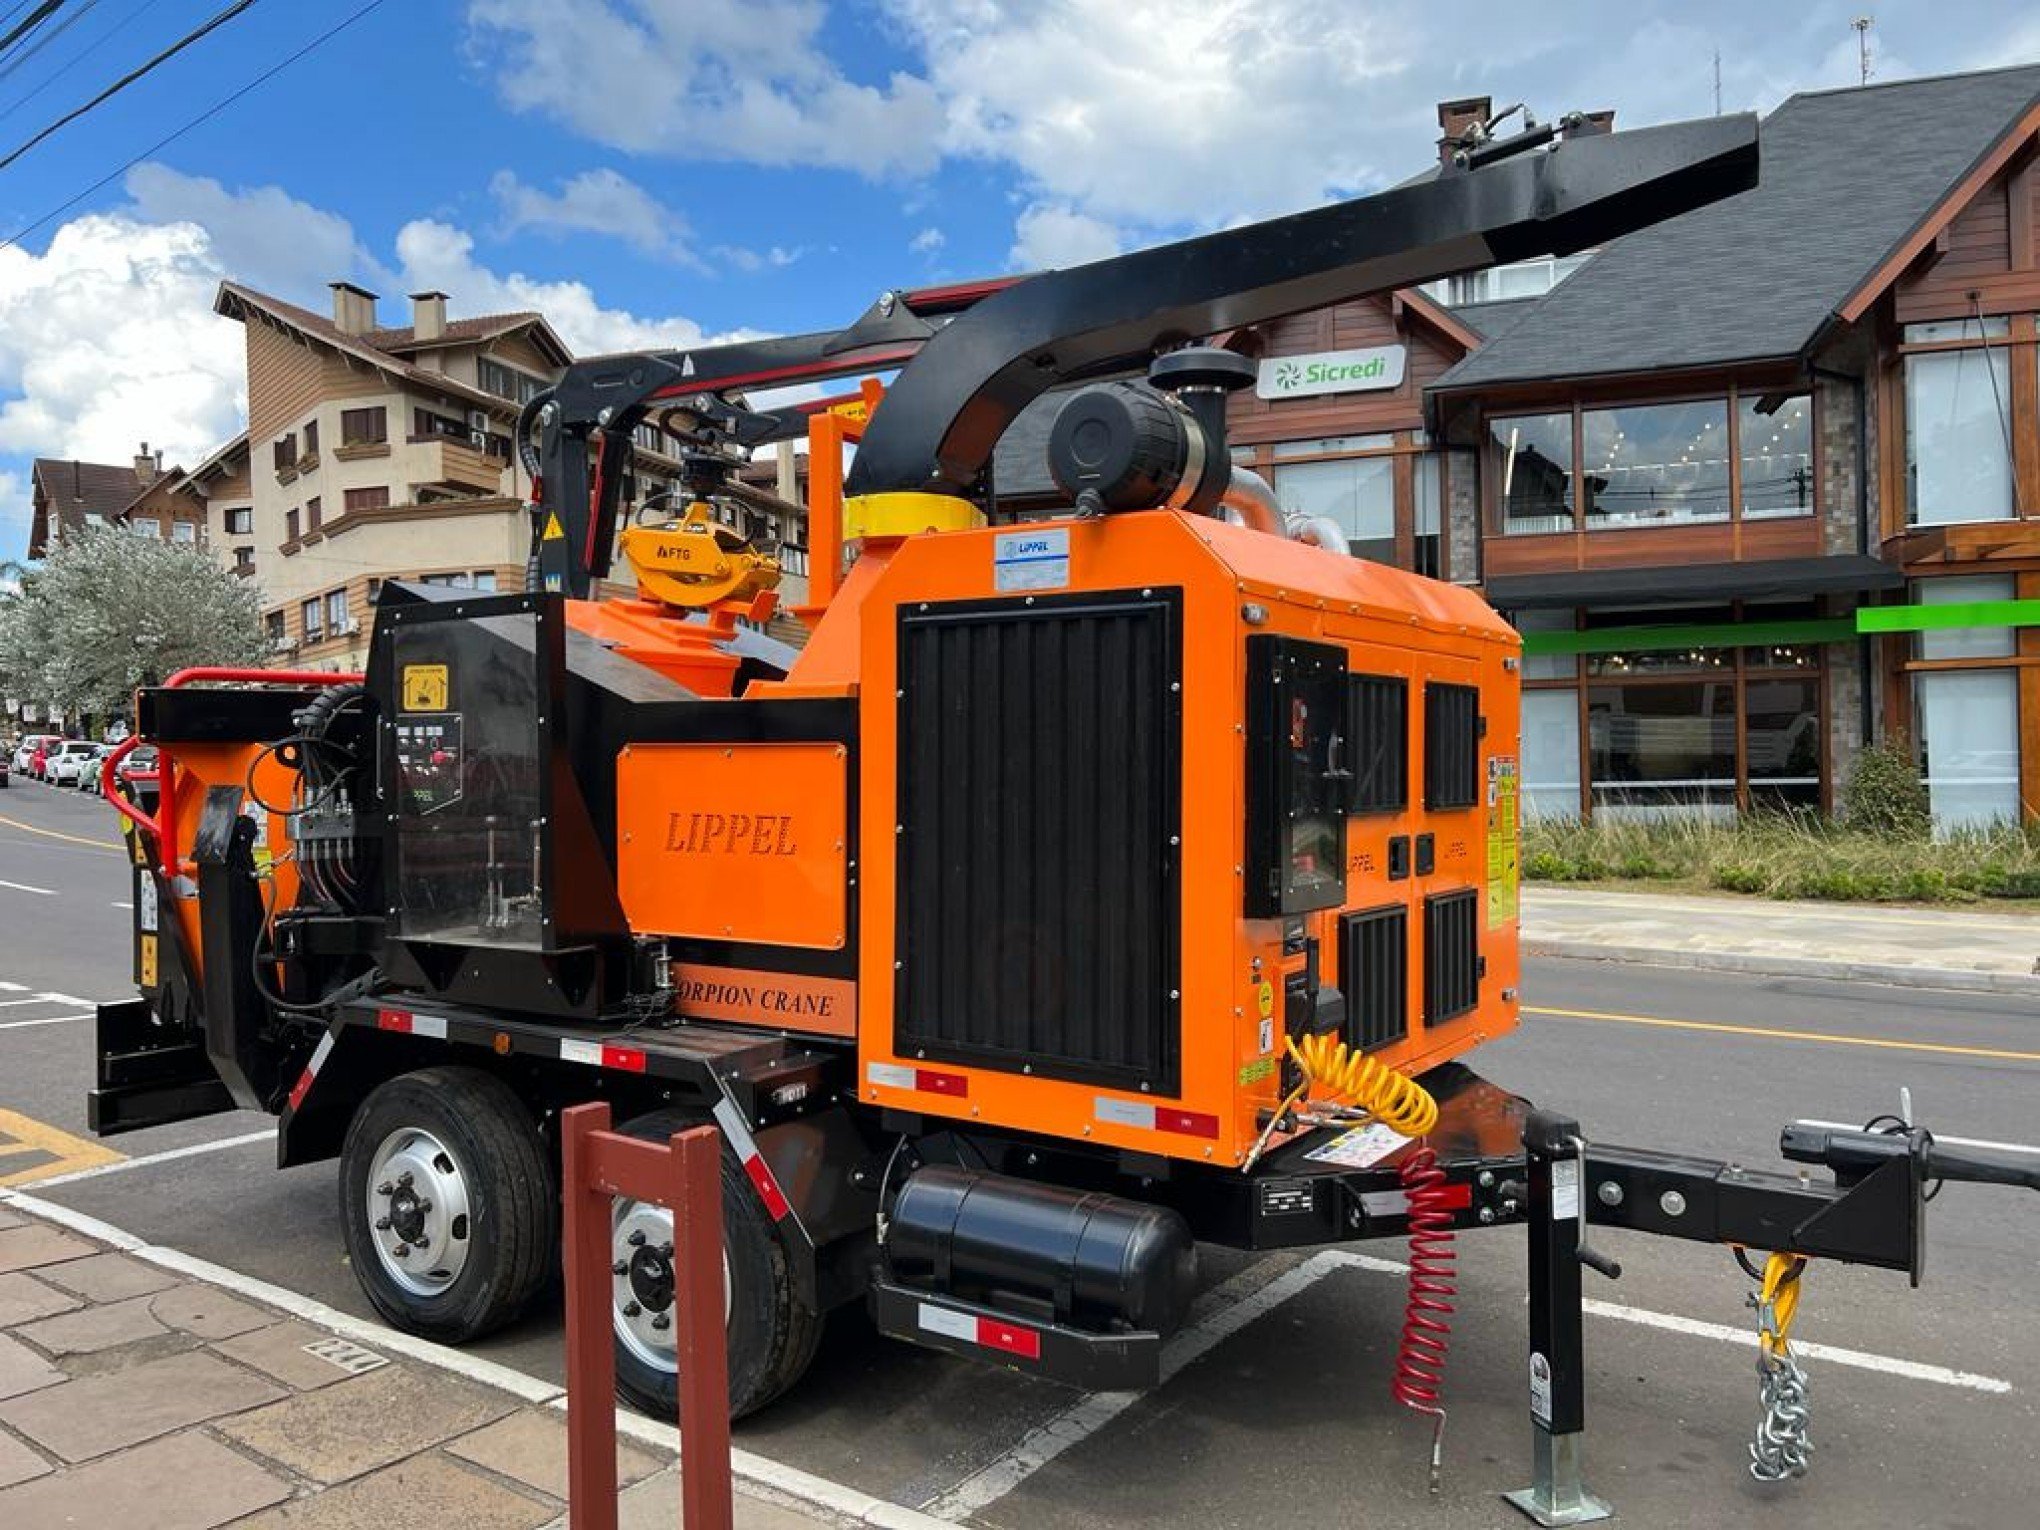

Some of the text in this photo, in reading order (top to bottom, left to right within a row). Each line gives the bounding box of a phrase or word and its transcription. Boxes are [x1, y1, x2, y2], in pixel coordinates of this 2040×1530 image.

[1307, 357, 1385, 383] Sicredi
[665, 812, 797, 856] LIPPEL
[677, 980, 833, 1016] ORPION CRANE
